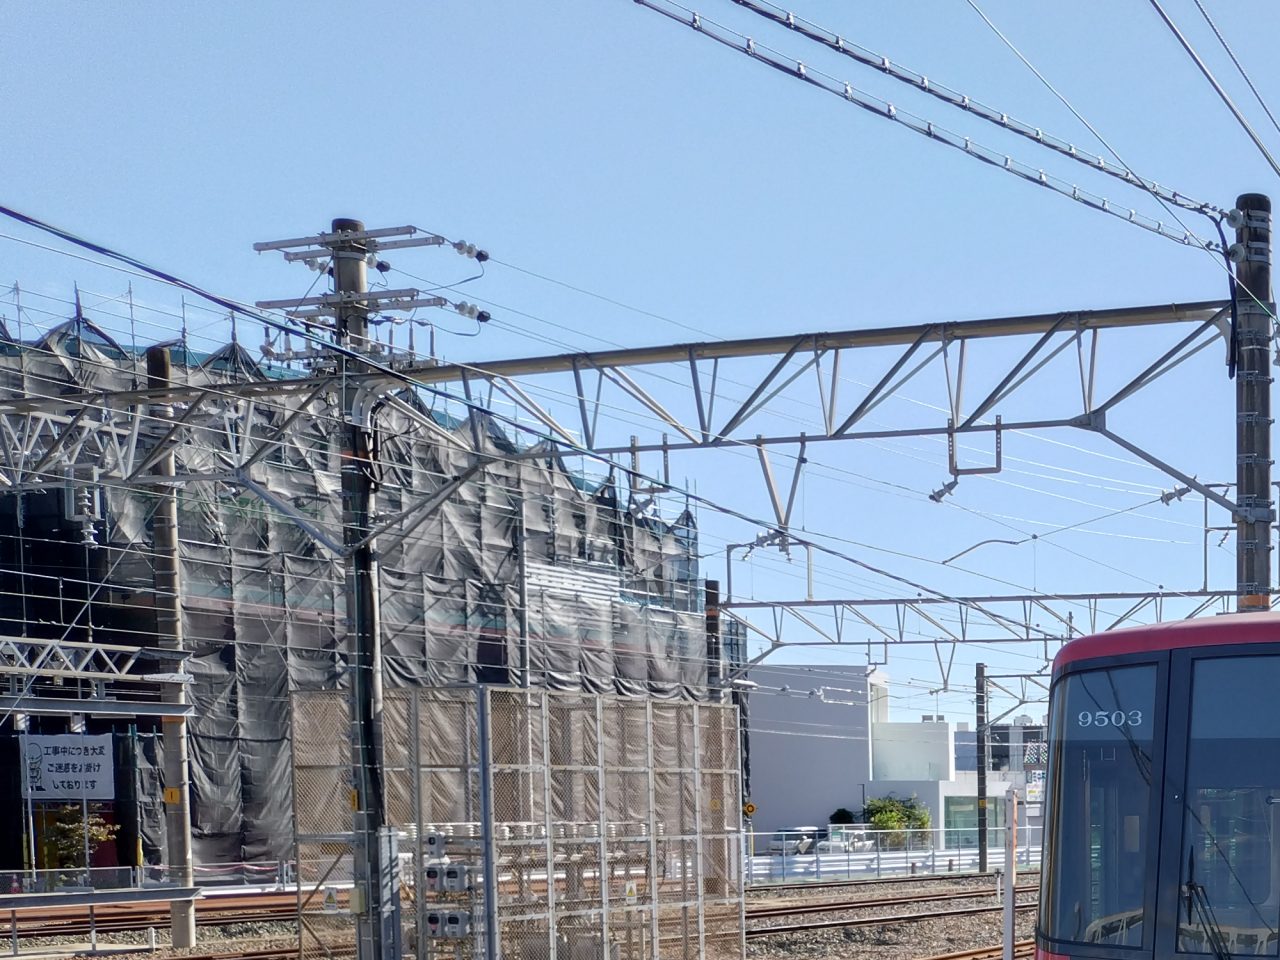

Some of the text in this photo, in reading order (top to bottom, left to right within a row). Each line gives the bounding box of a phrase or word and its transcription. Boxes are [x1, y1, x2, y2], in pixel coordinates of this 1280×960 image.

[1078, 710, 1142, 727] 9503
[43, 746, 105, 756] 工事中につき大変
